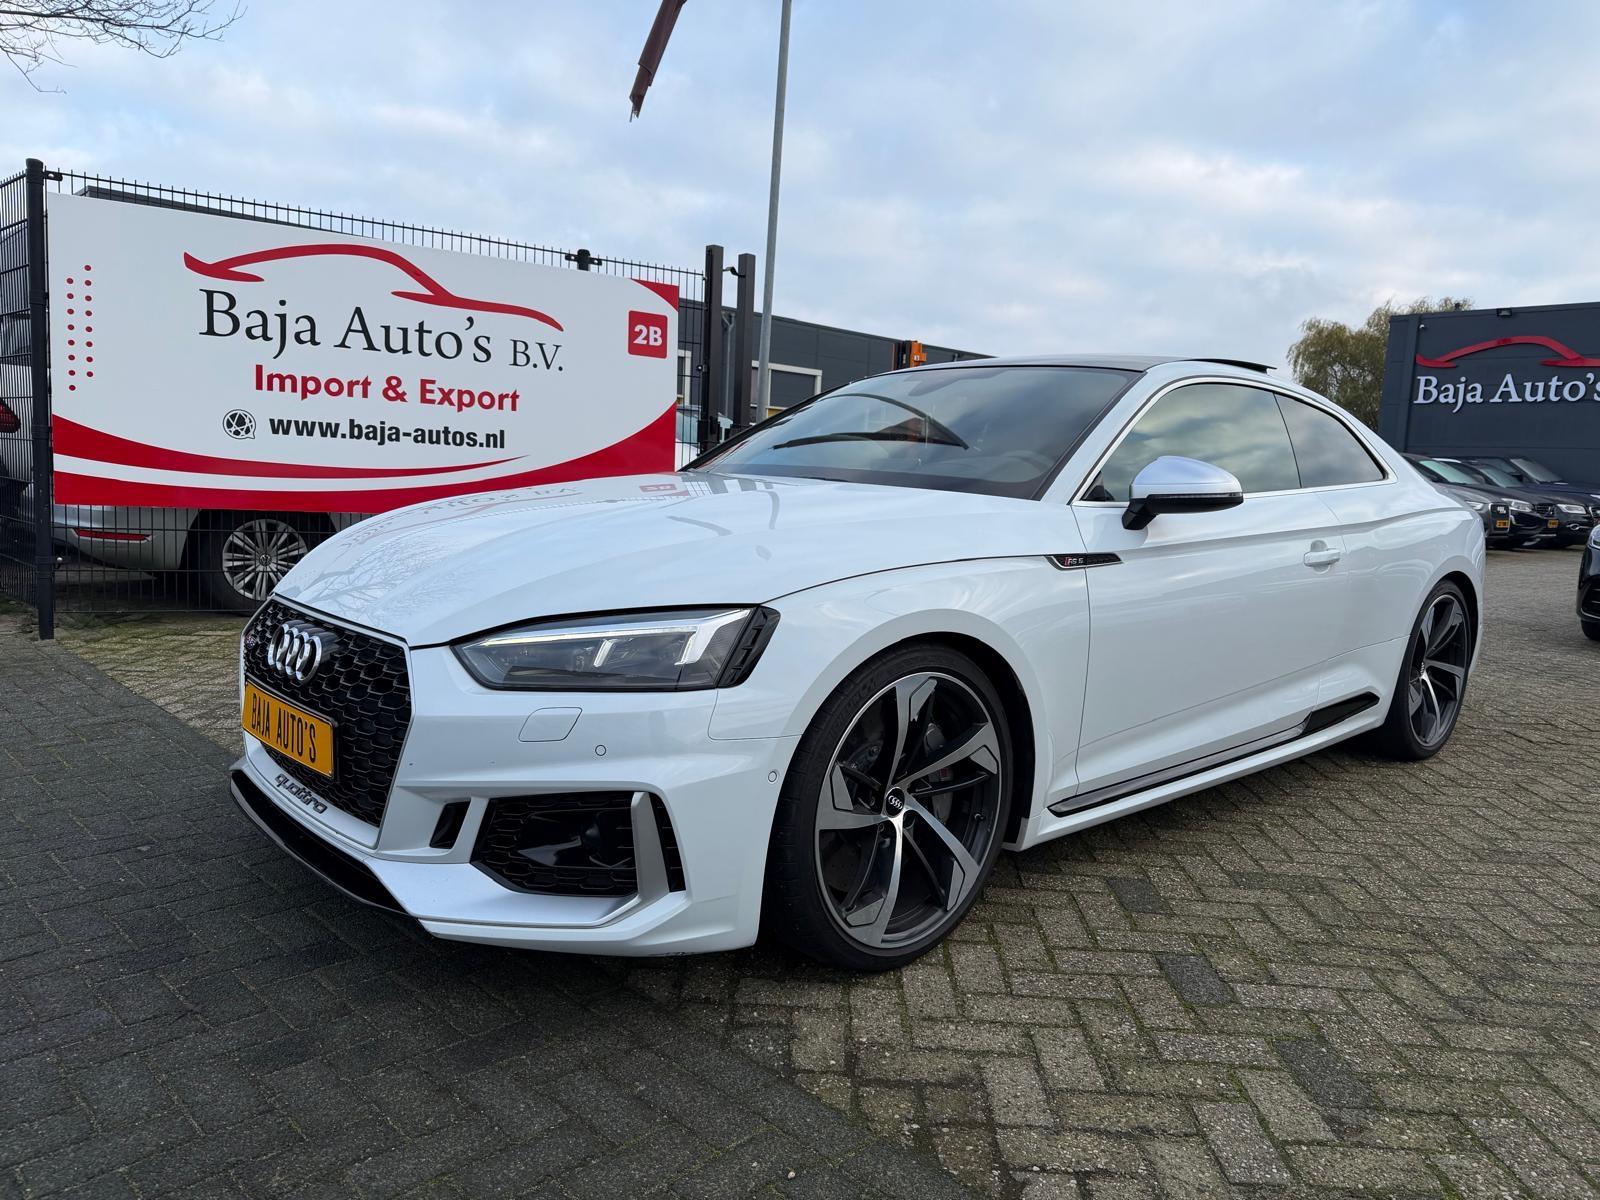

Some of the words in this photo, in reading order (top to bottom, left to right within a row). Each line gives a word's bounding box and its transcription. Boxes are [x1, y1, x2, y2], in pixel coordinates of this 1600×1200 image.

[199, 288, 321, 360] Baja
[333, 306, 493, 363] Auto's
[509, 338, 564, 372] B.V.
[633, 324, 663, 347] 2B
[255, 364, 372, 401] Import
[382, 375, 408, 403] &
[419, 378, 521, 412] Export
[1413, 375, 1484, 413] Baja
[269, 418, 506, 449] www.baja-autos.nl
[251, 692, 271, 740] BAJA
[276, 706, 317, 763] AUTO'S
[275, 773, 328, 814] quattro
